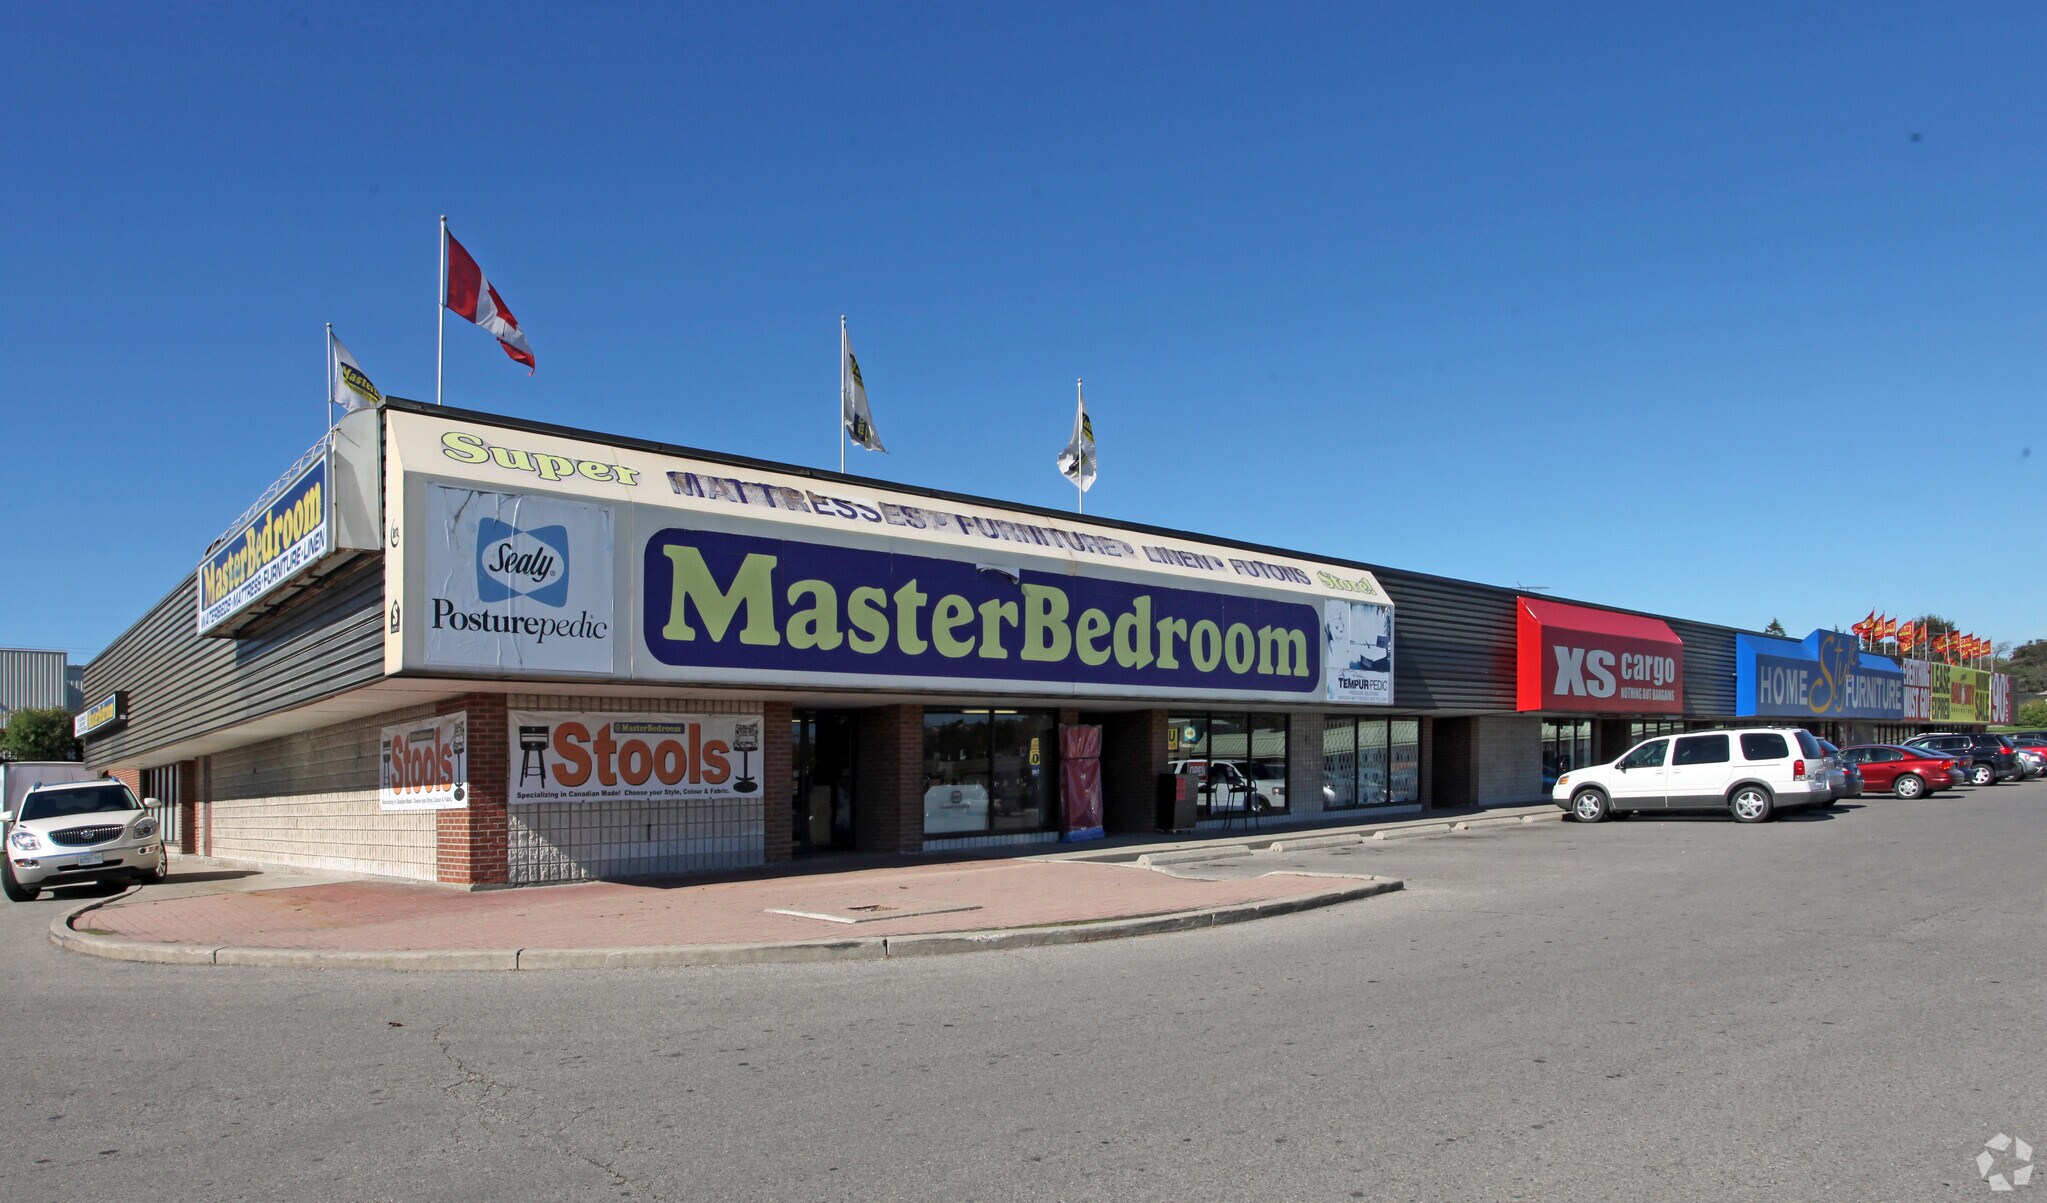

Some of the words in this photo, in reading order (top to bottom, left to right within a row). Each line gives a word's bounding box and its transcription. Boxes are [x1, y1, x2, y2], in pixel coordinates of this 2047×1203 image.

[202, 481, 322, 610] MasterBedroom
[440, 431, 641, 486] Super
[666, 470, 927, 530] MATTRESSES
[954, 514, 1122, 557] FURNITURE
[1142, 545, 1213, 571] LINEN
[1228, 558, 1312, 586] FUTONS
[1316, 570, 1378, 596] Store!
[233, 575, 262, 607] MATTRESS
[263, 550, 301, 589] FURNITURE
[303, 527, 325, 560] LINEN
[488, 542, 554, 582] Sealy
[431, 597, 608, 644] Posturepedic
[661, 543, 1310, 678] MasterBedroom
[1553, 645, 1617, 699] XS
[1621, 652, 1675, 686] cargo
[1760, 666, 1809, 706] HOME
[1808, 634, 1858, 713] Style
[1845, 673, 1902, 710] FURNITURE
[391, 726, 454, 796] Stools
[551, 721, 732, 788] Stools
[516, 791, 559, 799] Specializing
[568, 790, 600, 798] Canadian
[664, 789, 682, 797] Style,
